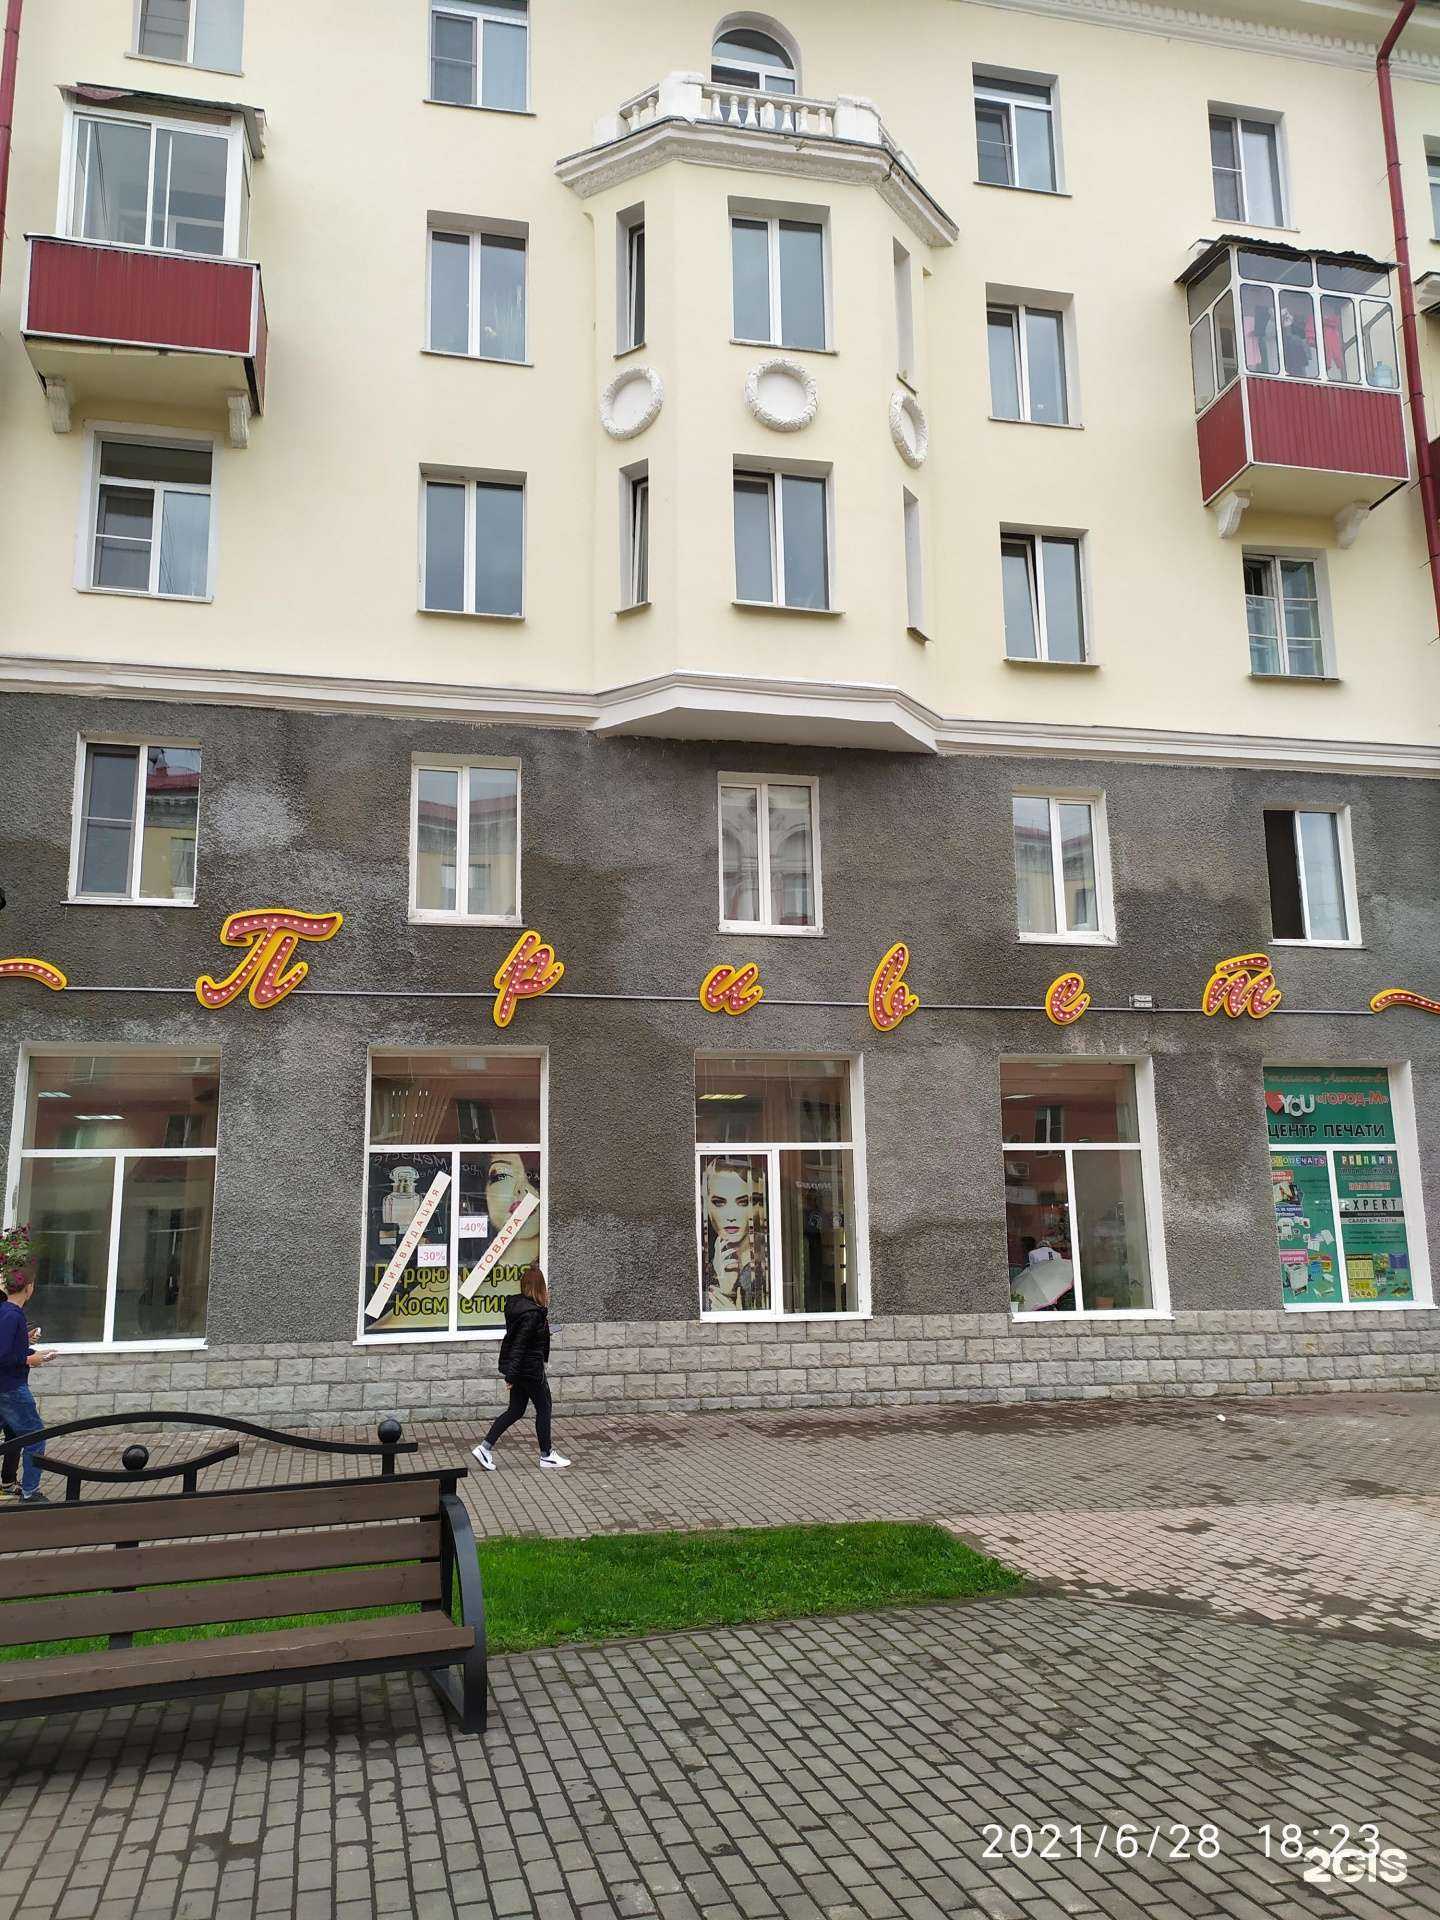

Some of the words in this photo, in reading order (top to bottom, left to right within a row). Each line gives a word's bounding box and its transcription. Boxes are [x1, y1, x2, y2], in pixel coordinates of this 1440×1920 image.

[1279, 1094, 1316, 1117] YOU
[1268, 1124, 1317, 1138] ЦЕНТР
[1323, 1124, 1385, 1137] ПЕЧАТИ
[1344, 1199, 1397, 1211] EXPERT
[383, 1189, 440, 1290] ЛИКВИДАЦИЯ
[477, 1218, 522, 1272] ТОВАРА
[419, 1251, 446, 1261] -30%
